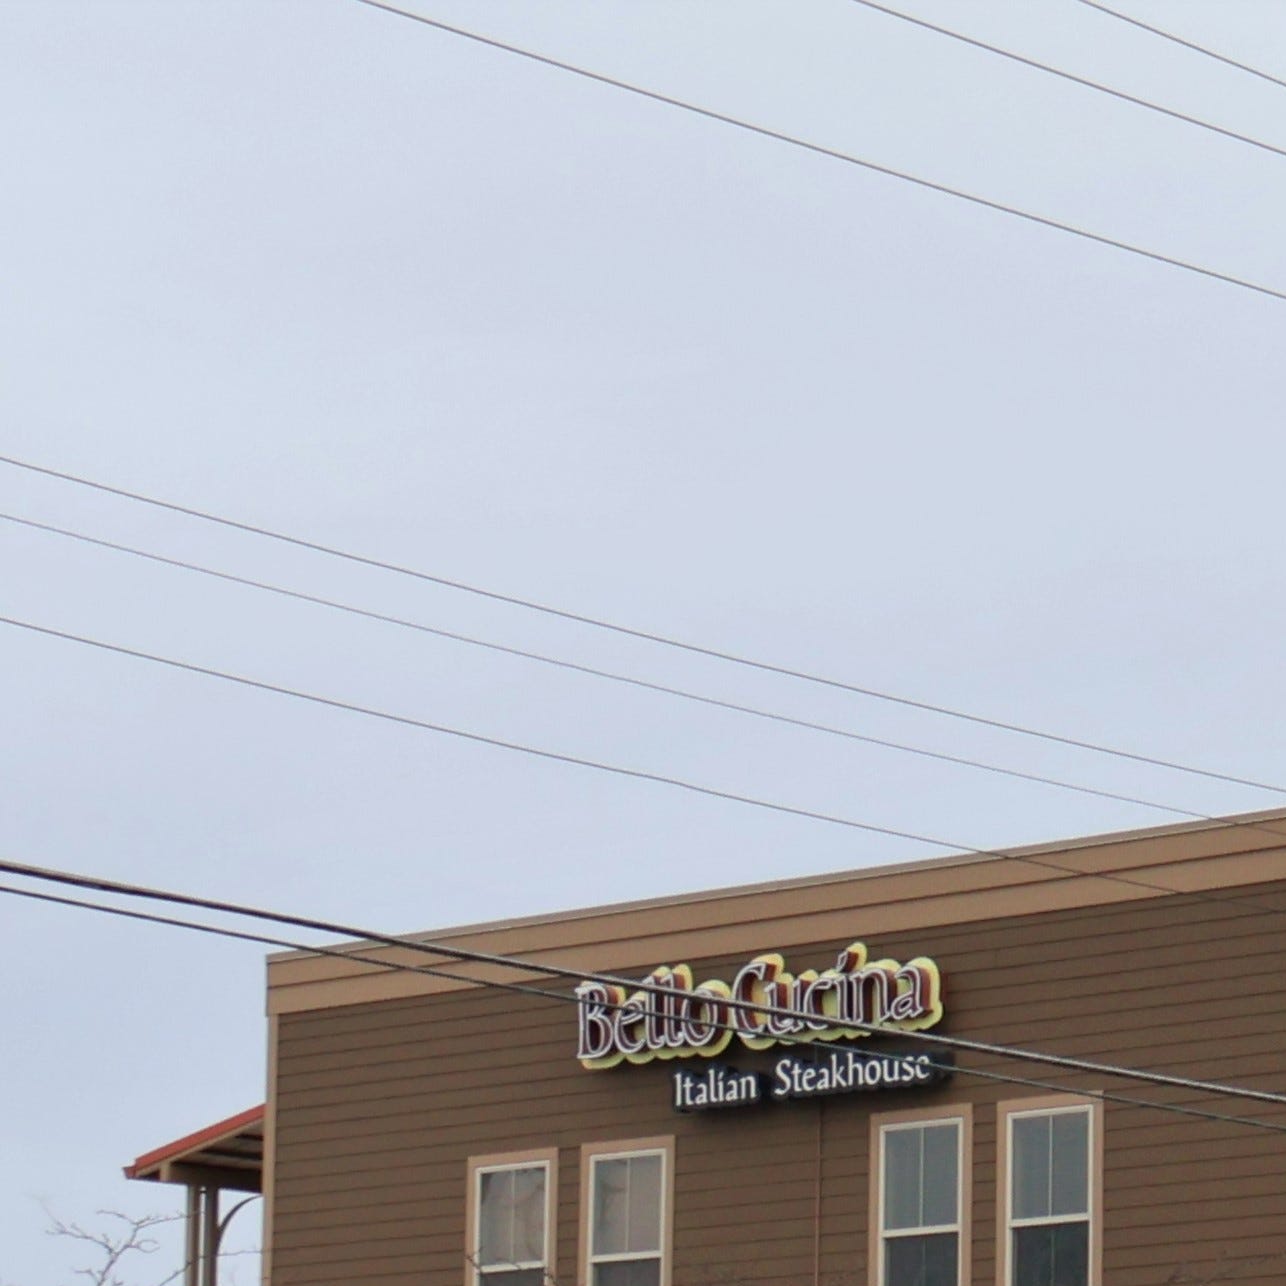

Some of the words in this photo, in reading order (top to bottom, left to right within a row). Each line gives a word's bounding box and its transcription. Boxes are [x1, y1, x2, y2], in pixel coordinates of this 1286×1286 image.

[575, 964, 729, 1062] Bello
[732, 947, 938, 1041] Cucina
[674, 1071, 757, 1106] Italian
[774, 1050, 931, 1096] Steakhouse
